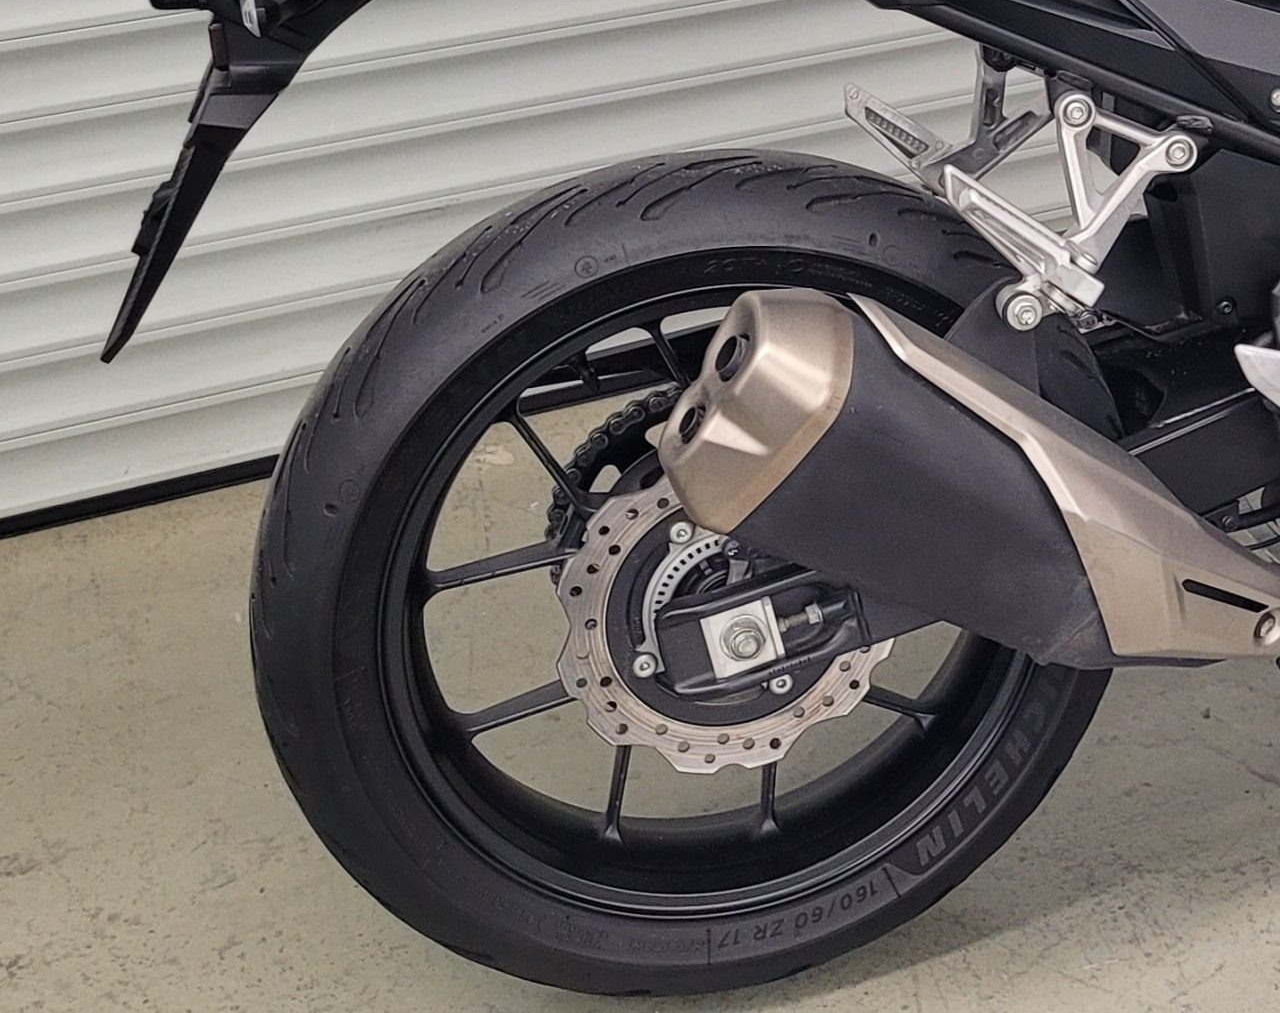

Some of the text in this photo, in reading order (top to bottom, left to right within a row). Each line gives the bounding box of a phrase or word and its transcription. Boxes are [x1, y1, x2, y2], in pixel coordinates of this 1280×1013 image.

[794, 878, 878, 930] 160/60
[717, 928, 740, 949] 17
[753, 918, 784, 941] ZR
